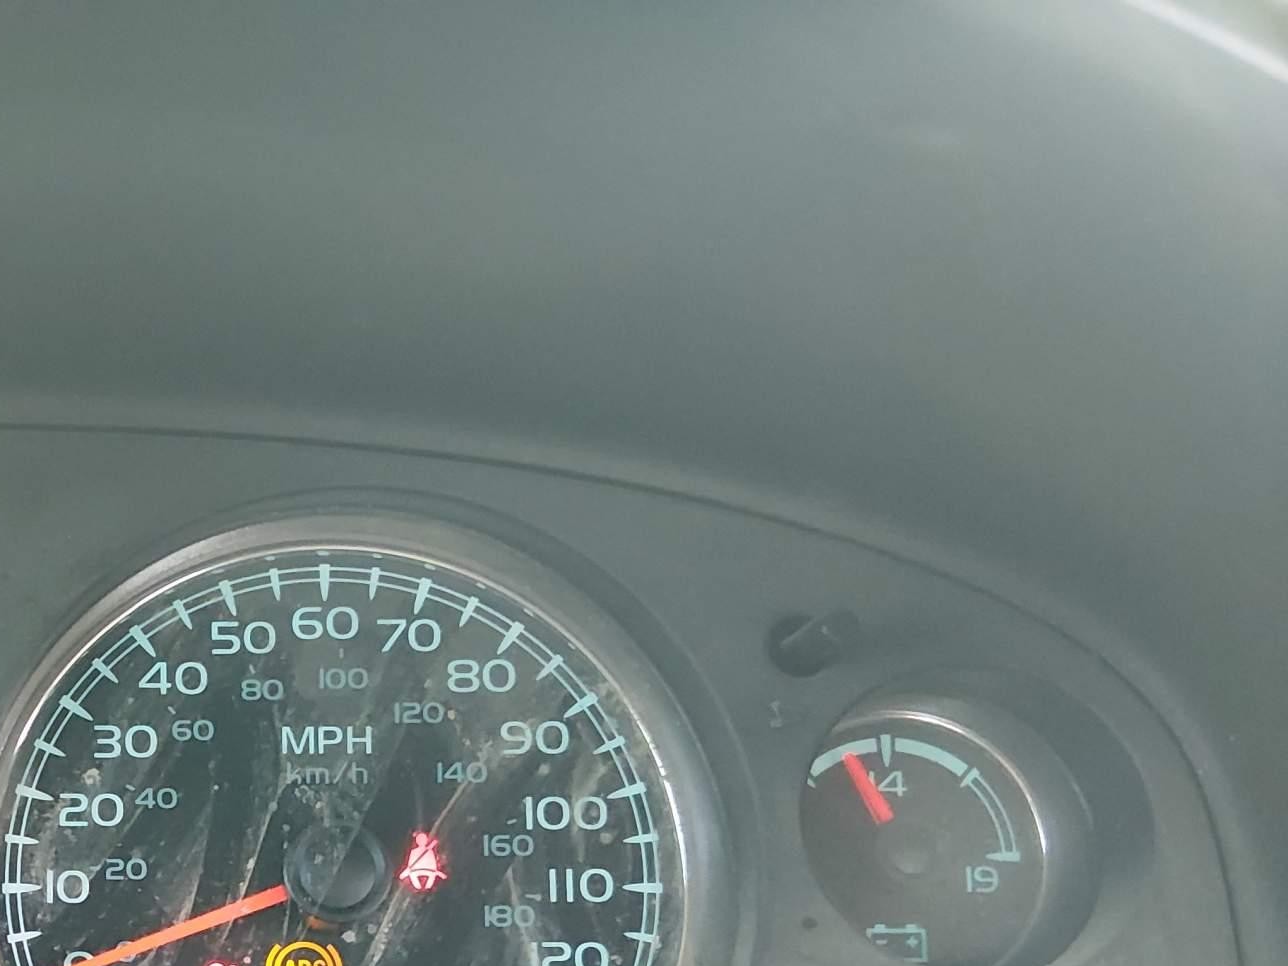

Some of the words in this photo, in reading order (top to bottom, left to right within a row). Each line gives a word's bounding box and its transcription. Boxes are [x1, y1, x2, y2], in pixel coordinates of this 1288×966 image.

[211, 621, 277, 655] 50
[291, 606, 359, 640] 60
[376, 618, 441, 653] 70
[138, 661, 209, 695] 40
[241, 679, 285, 701] 80
[318, 667, 369, 690] 100
[446, 659, 516, 693] 80
[393, 702, 446, 725] 120
[93, 725, 158, 759] 30
[171, 719, 215, 742] 60
[281, 725, 373, 755] MPH
[499, 721, 570, 755] 90
[285, 761, 369, 785] km/h
[436, 762, 487, 784] 140
[58, 793, 124, 827] 20
[135, 788, 178, 809] 40
[523, 796, 608, 831] 100
[482, 834, 534, 857] 160
[105, 857, 148, 881] 20
[965, 866, 999, 893] 19
[46, 869, 90, 904] 10
[548, 868, 614, 903] 110
[484, 905, 535, 928] 180
